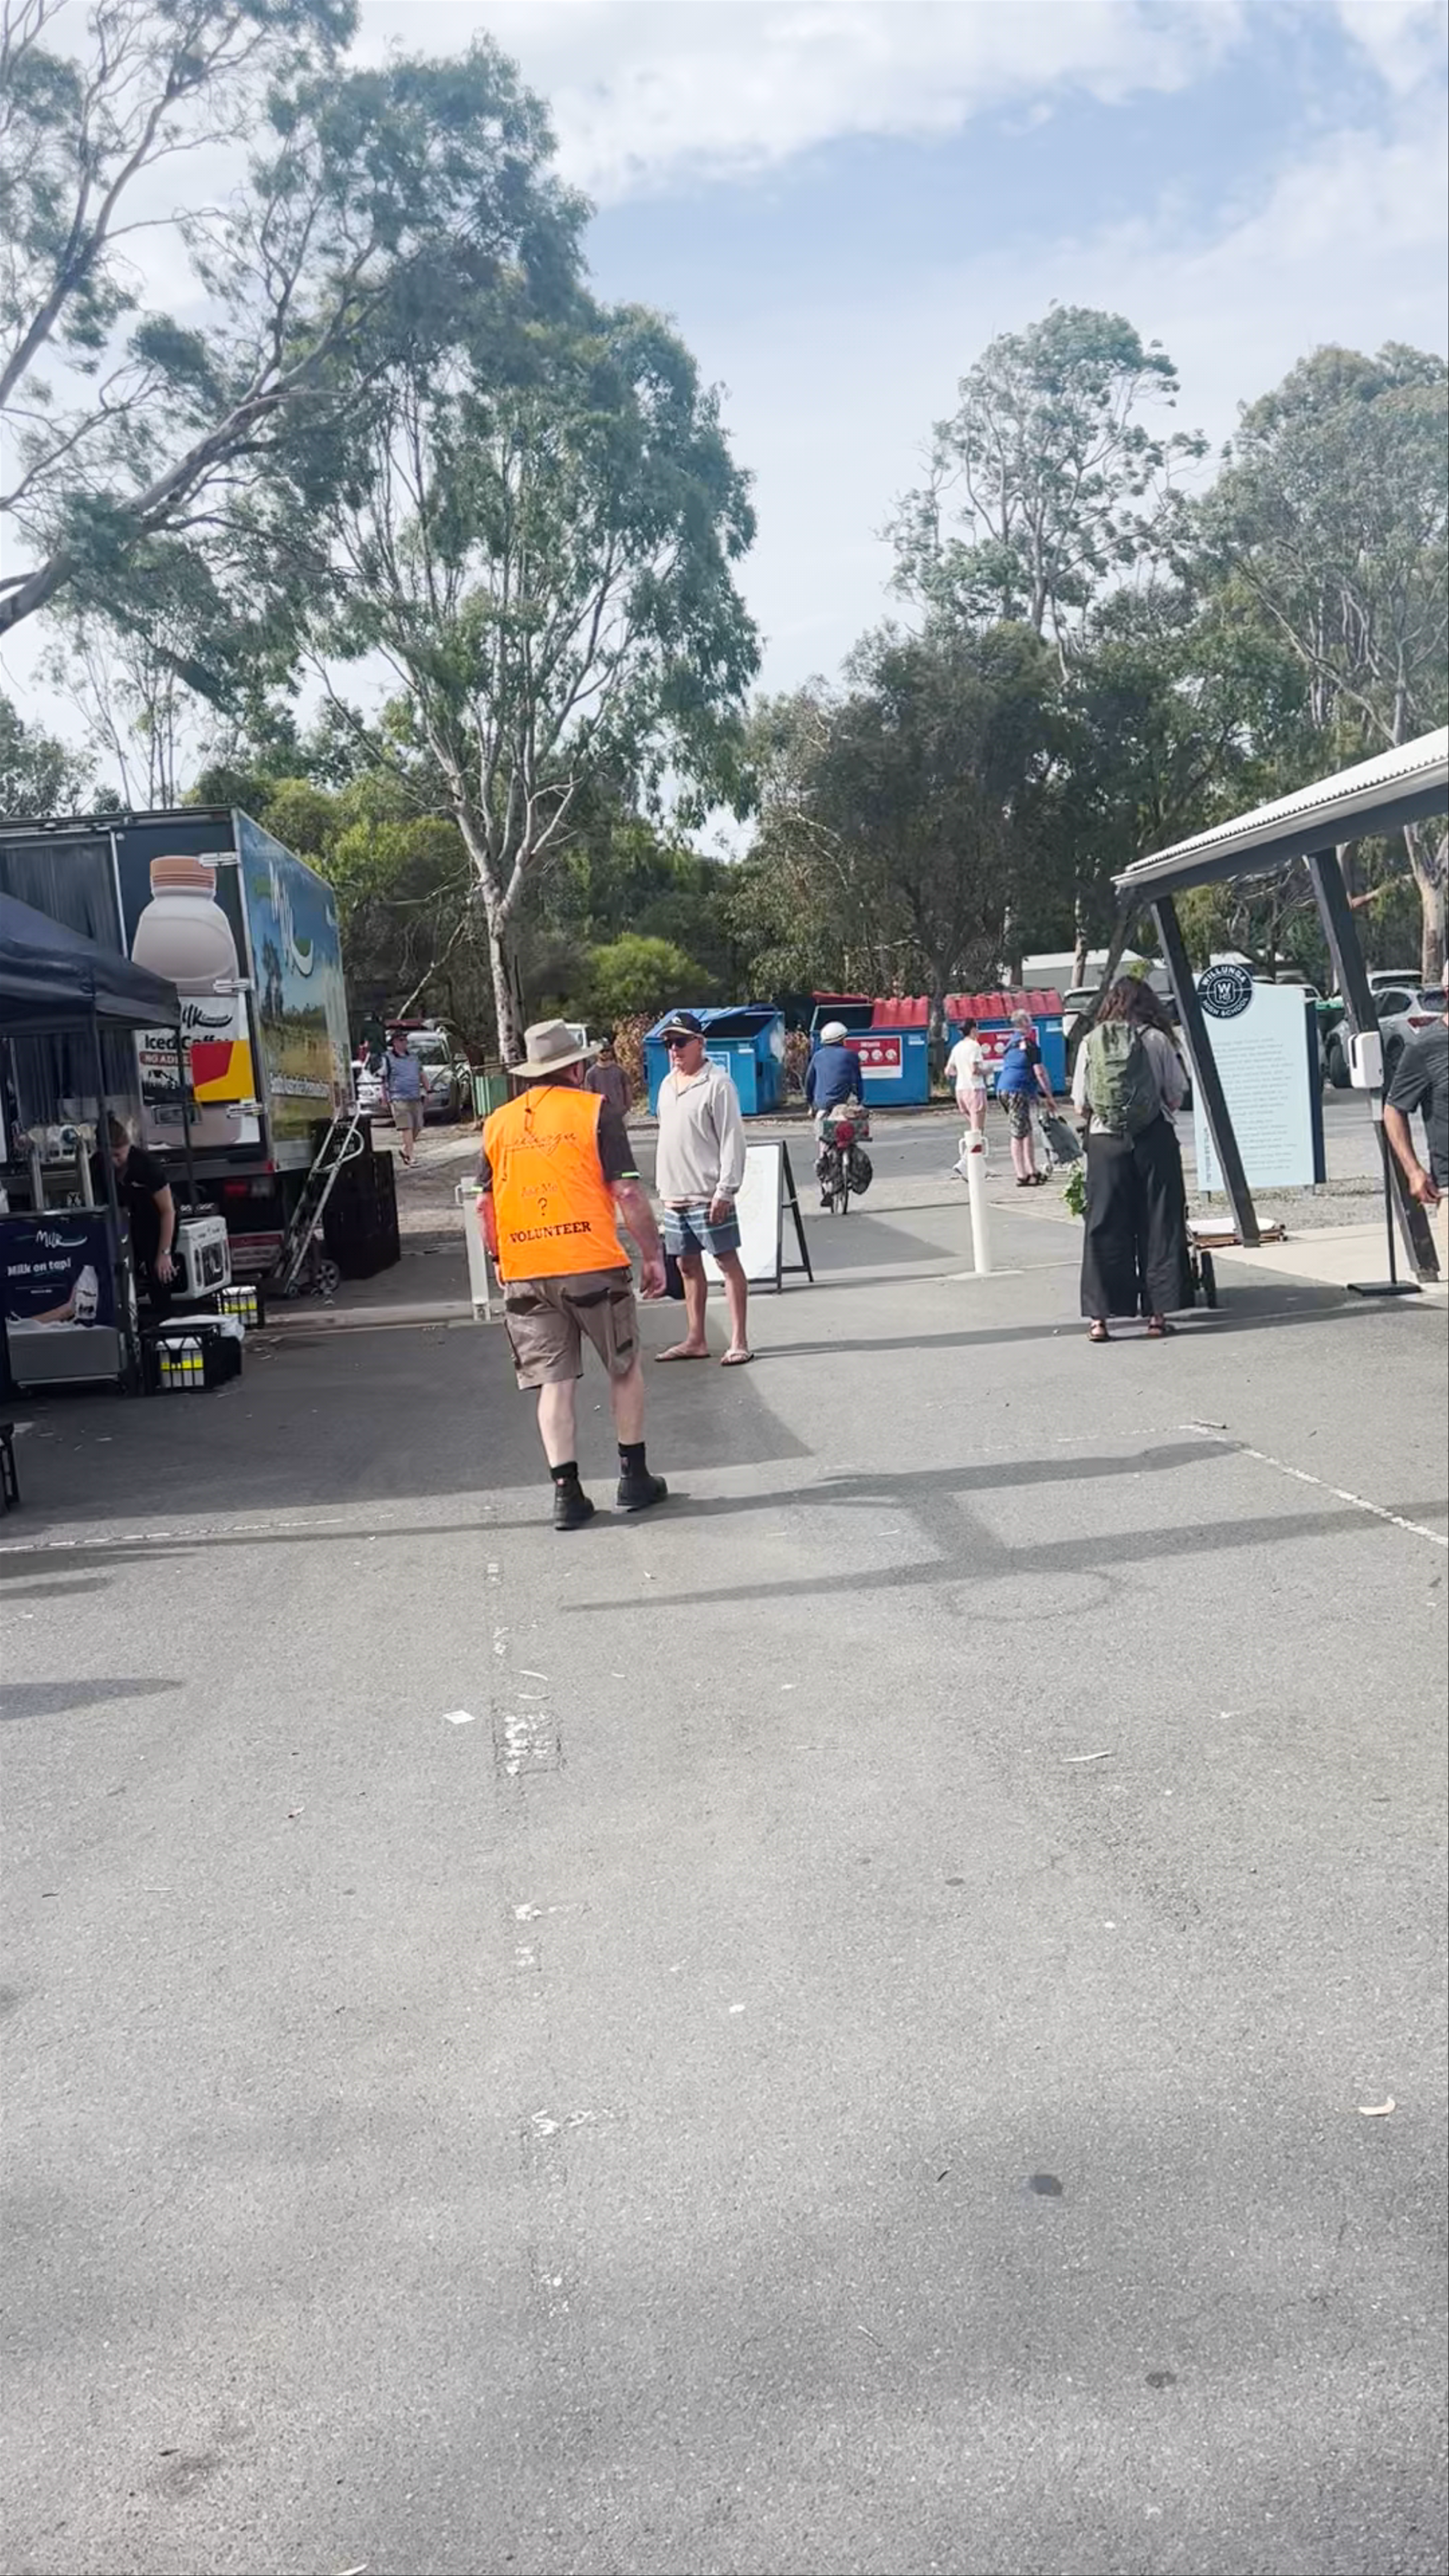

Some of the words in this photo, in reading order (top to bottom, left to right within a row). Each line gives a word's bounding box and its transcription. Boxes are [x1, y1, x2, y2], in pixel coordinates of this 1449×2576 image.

[1201, 966, 1246, 986] WILLUNGA
[1202, 1000, 1219, 1015] HIGH
[1221, 997, 1249, 1017] SCHOOL
[510, 1221, 591, 1243] VOLUNTEER
[8, 1264, 31, 1276] Milk
[33, 1264, 47, 1272] on
[49, 1257, 71, 1270] tap!
